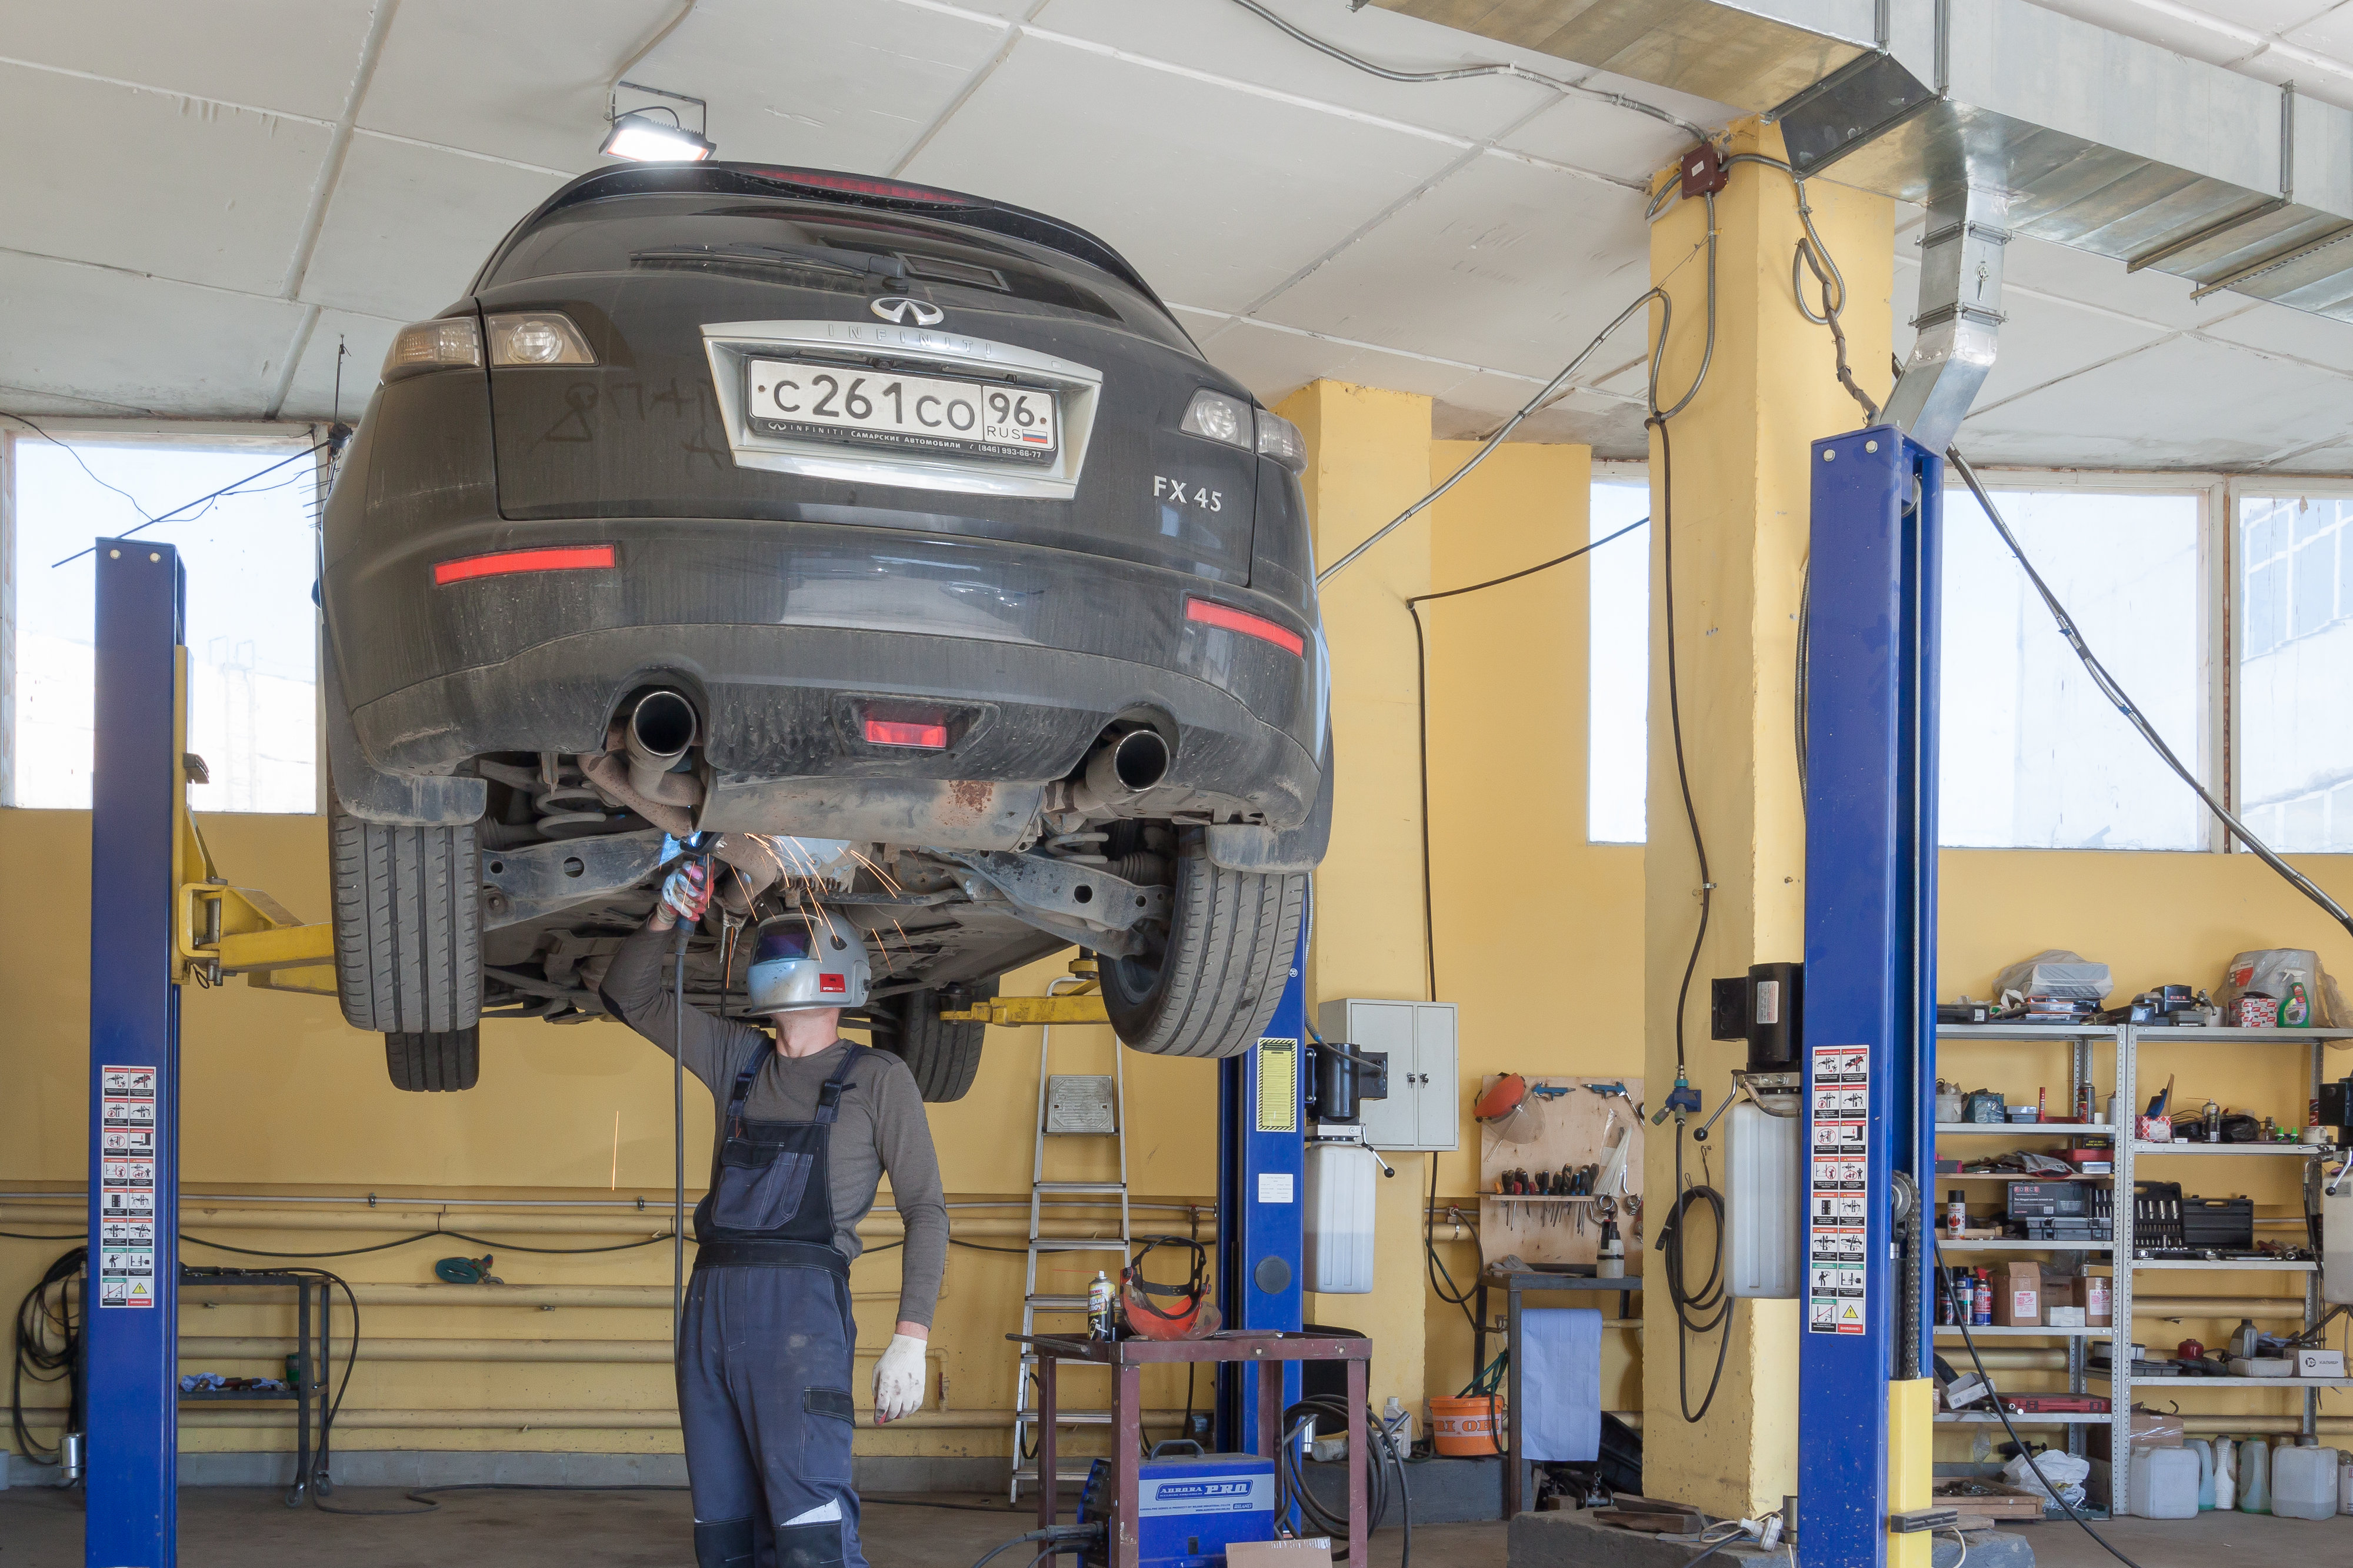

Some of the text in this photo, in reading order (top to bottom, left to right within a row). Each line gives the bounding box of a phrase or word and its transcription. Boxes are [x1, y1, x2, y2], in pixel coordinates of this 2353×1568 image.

[828, 323, 992, 355] INFINITI
[989, 392, 1035, 427] 96
[790, 424, 844, 436] INFINITI
[986, 425, 1021, 439] RUS
[978, 443, 1000, 454] (846)
[1002, 447, 1041, 458] 993-66-77
[1154, 475, 1222, 512] FX 45
[1204, 1483, 1248, 1494] PRO
